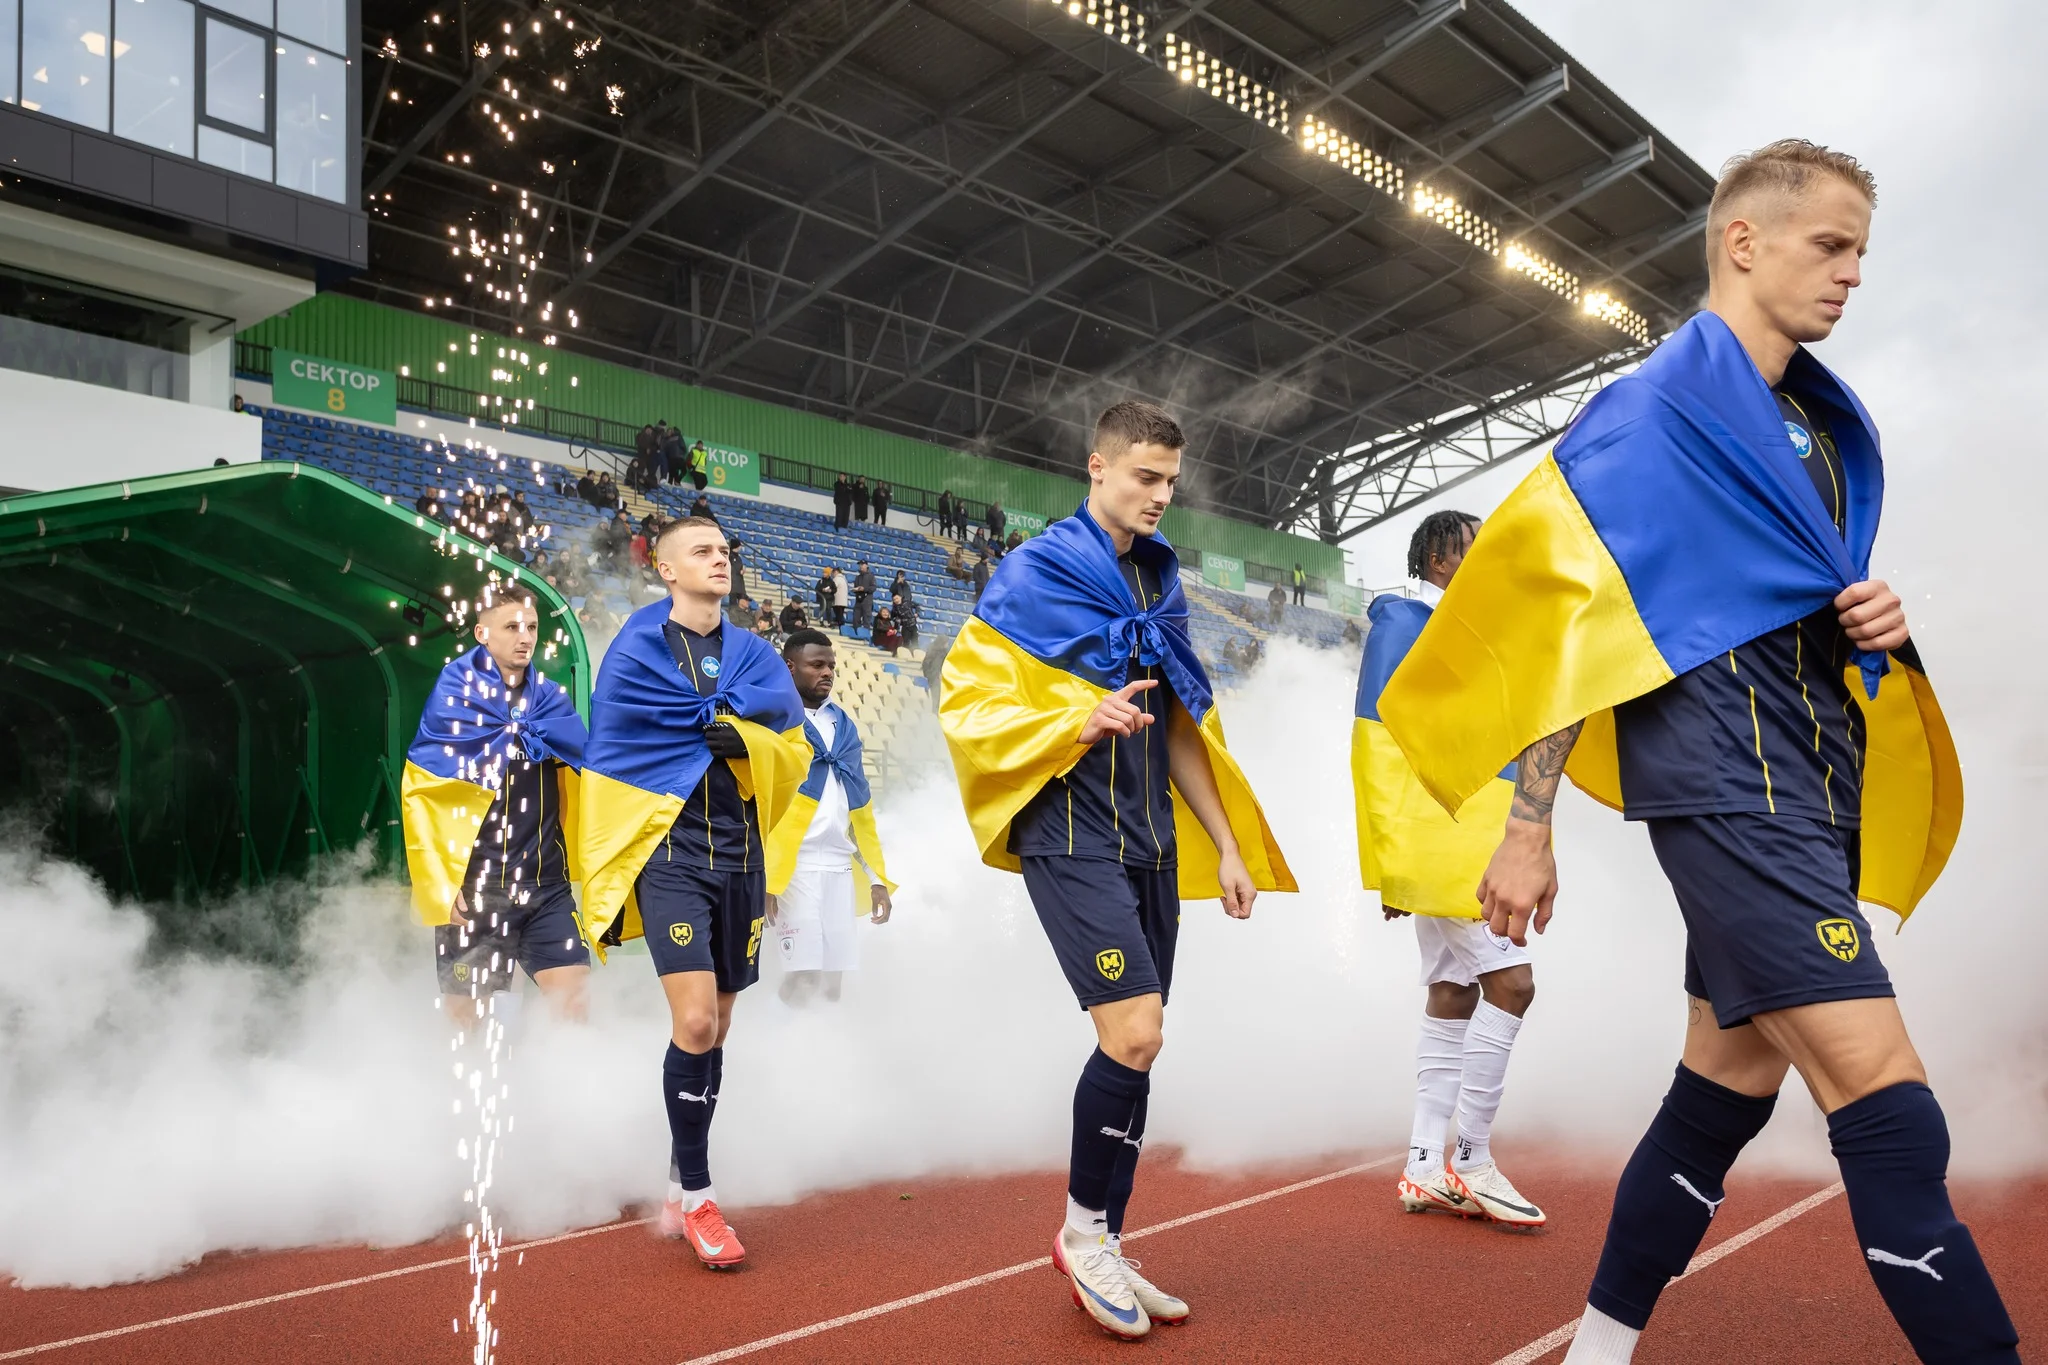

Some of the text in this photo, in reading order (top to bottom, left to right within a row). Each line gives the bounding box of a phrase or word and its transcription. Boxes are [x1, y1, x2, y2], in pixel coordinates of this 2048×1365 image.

[290, 359, 380, 391] СЕКТОР
[327, 388, 346, 411] 8
[688, 443, 749, 468] КТОР
[713, 466, 726, 485] 9
[1003, 511, 1043, 530] ЕКТОР
[1207, 556, 1240, 572] СЕКТОР
[673, 926, 690, 937] M
[1825, 925, 1854, 945] M
[1100, 953, 1120, 970] M
